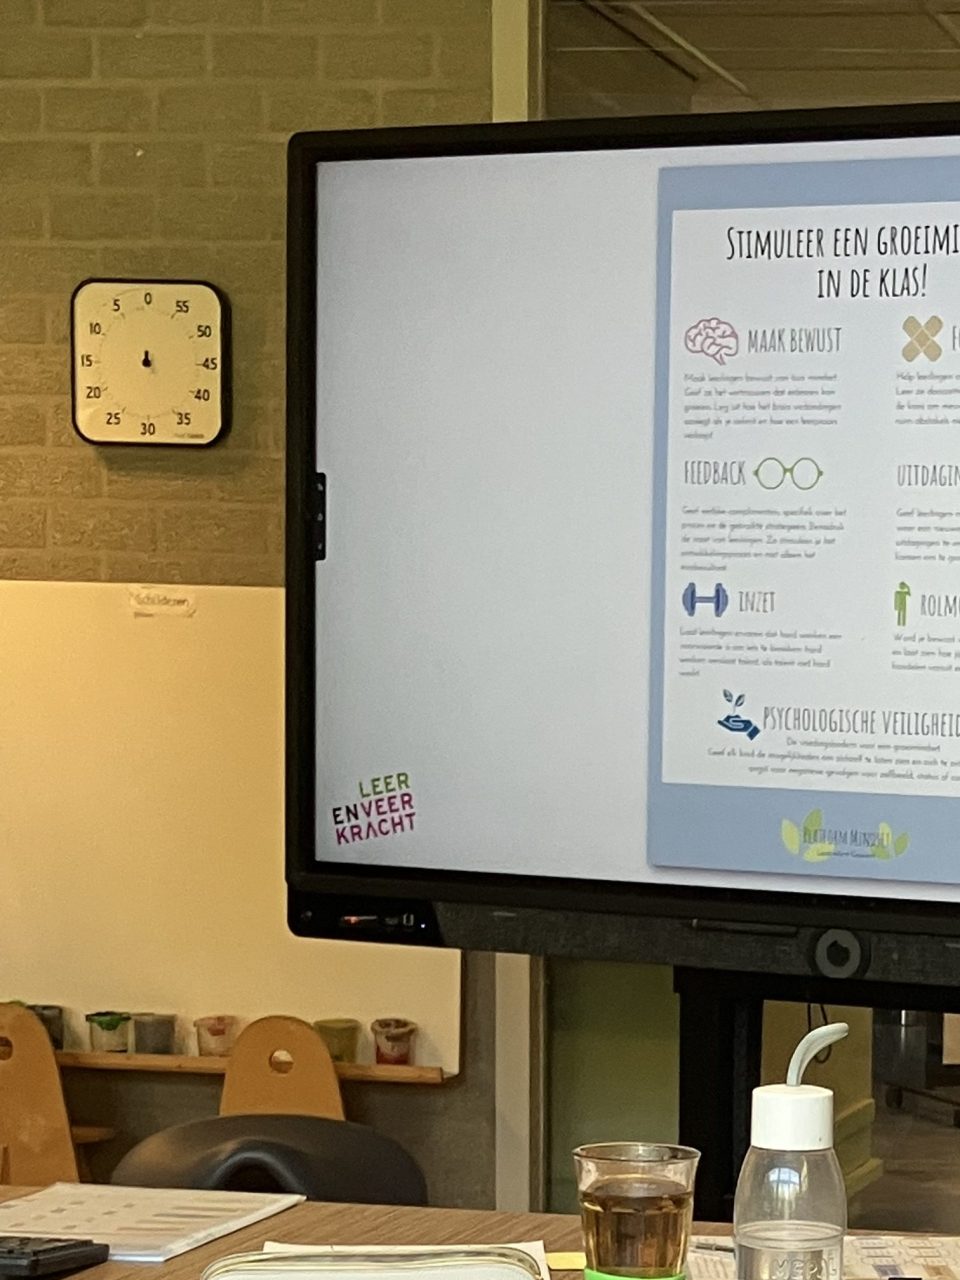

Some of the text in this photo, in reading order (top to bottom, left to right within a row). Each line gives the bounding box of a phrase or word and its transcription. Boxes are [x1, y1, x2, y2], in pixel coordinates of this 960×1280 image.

[727, 226, 825, 261] STIMULEER
[833, 226, 868, 257] EEN
[817, 263, 928, 299] IN DE KLAS!
[113, 299, 121, 312] 5
[144, 293, 153, 306] 0
[176, 300, 189, 314] 55
[90, 323, 101, 335] 10
[197, 325, 212, 338] 50
[748, 327, 843, 354] MAAK BEWUST
[81, 355, 93, 367] 15
[202, 358, 218, 370] 45
[86, 387, 101, 399] 20
[194, 389, 210, 401] 40
[106, 413, 121, 425] 25
[177, 413, 191, 425] 35
[141, 423, 156, 436] 30
[684, 460, 746, 486] FEEDBACK
[739, 592, 776, 613] INZET
[763, 706, 876, 735] PSYCHOLOGISCHE
[359, 772, 410, 799] LEER
[336, 812, 416, 846] KRACHT
